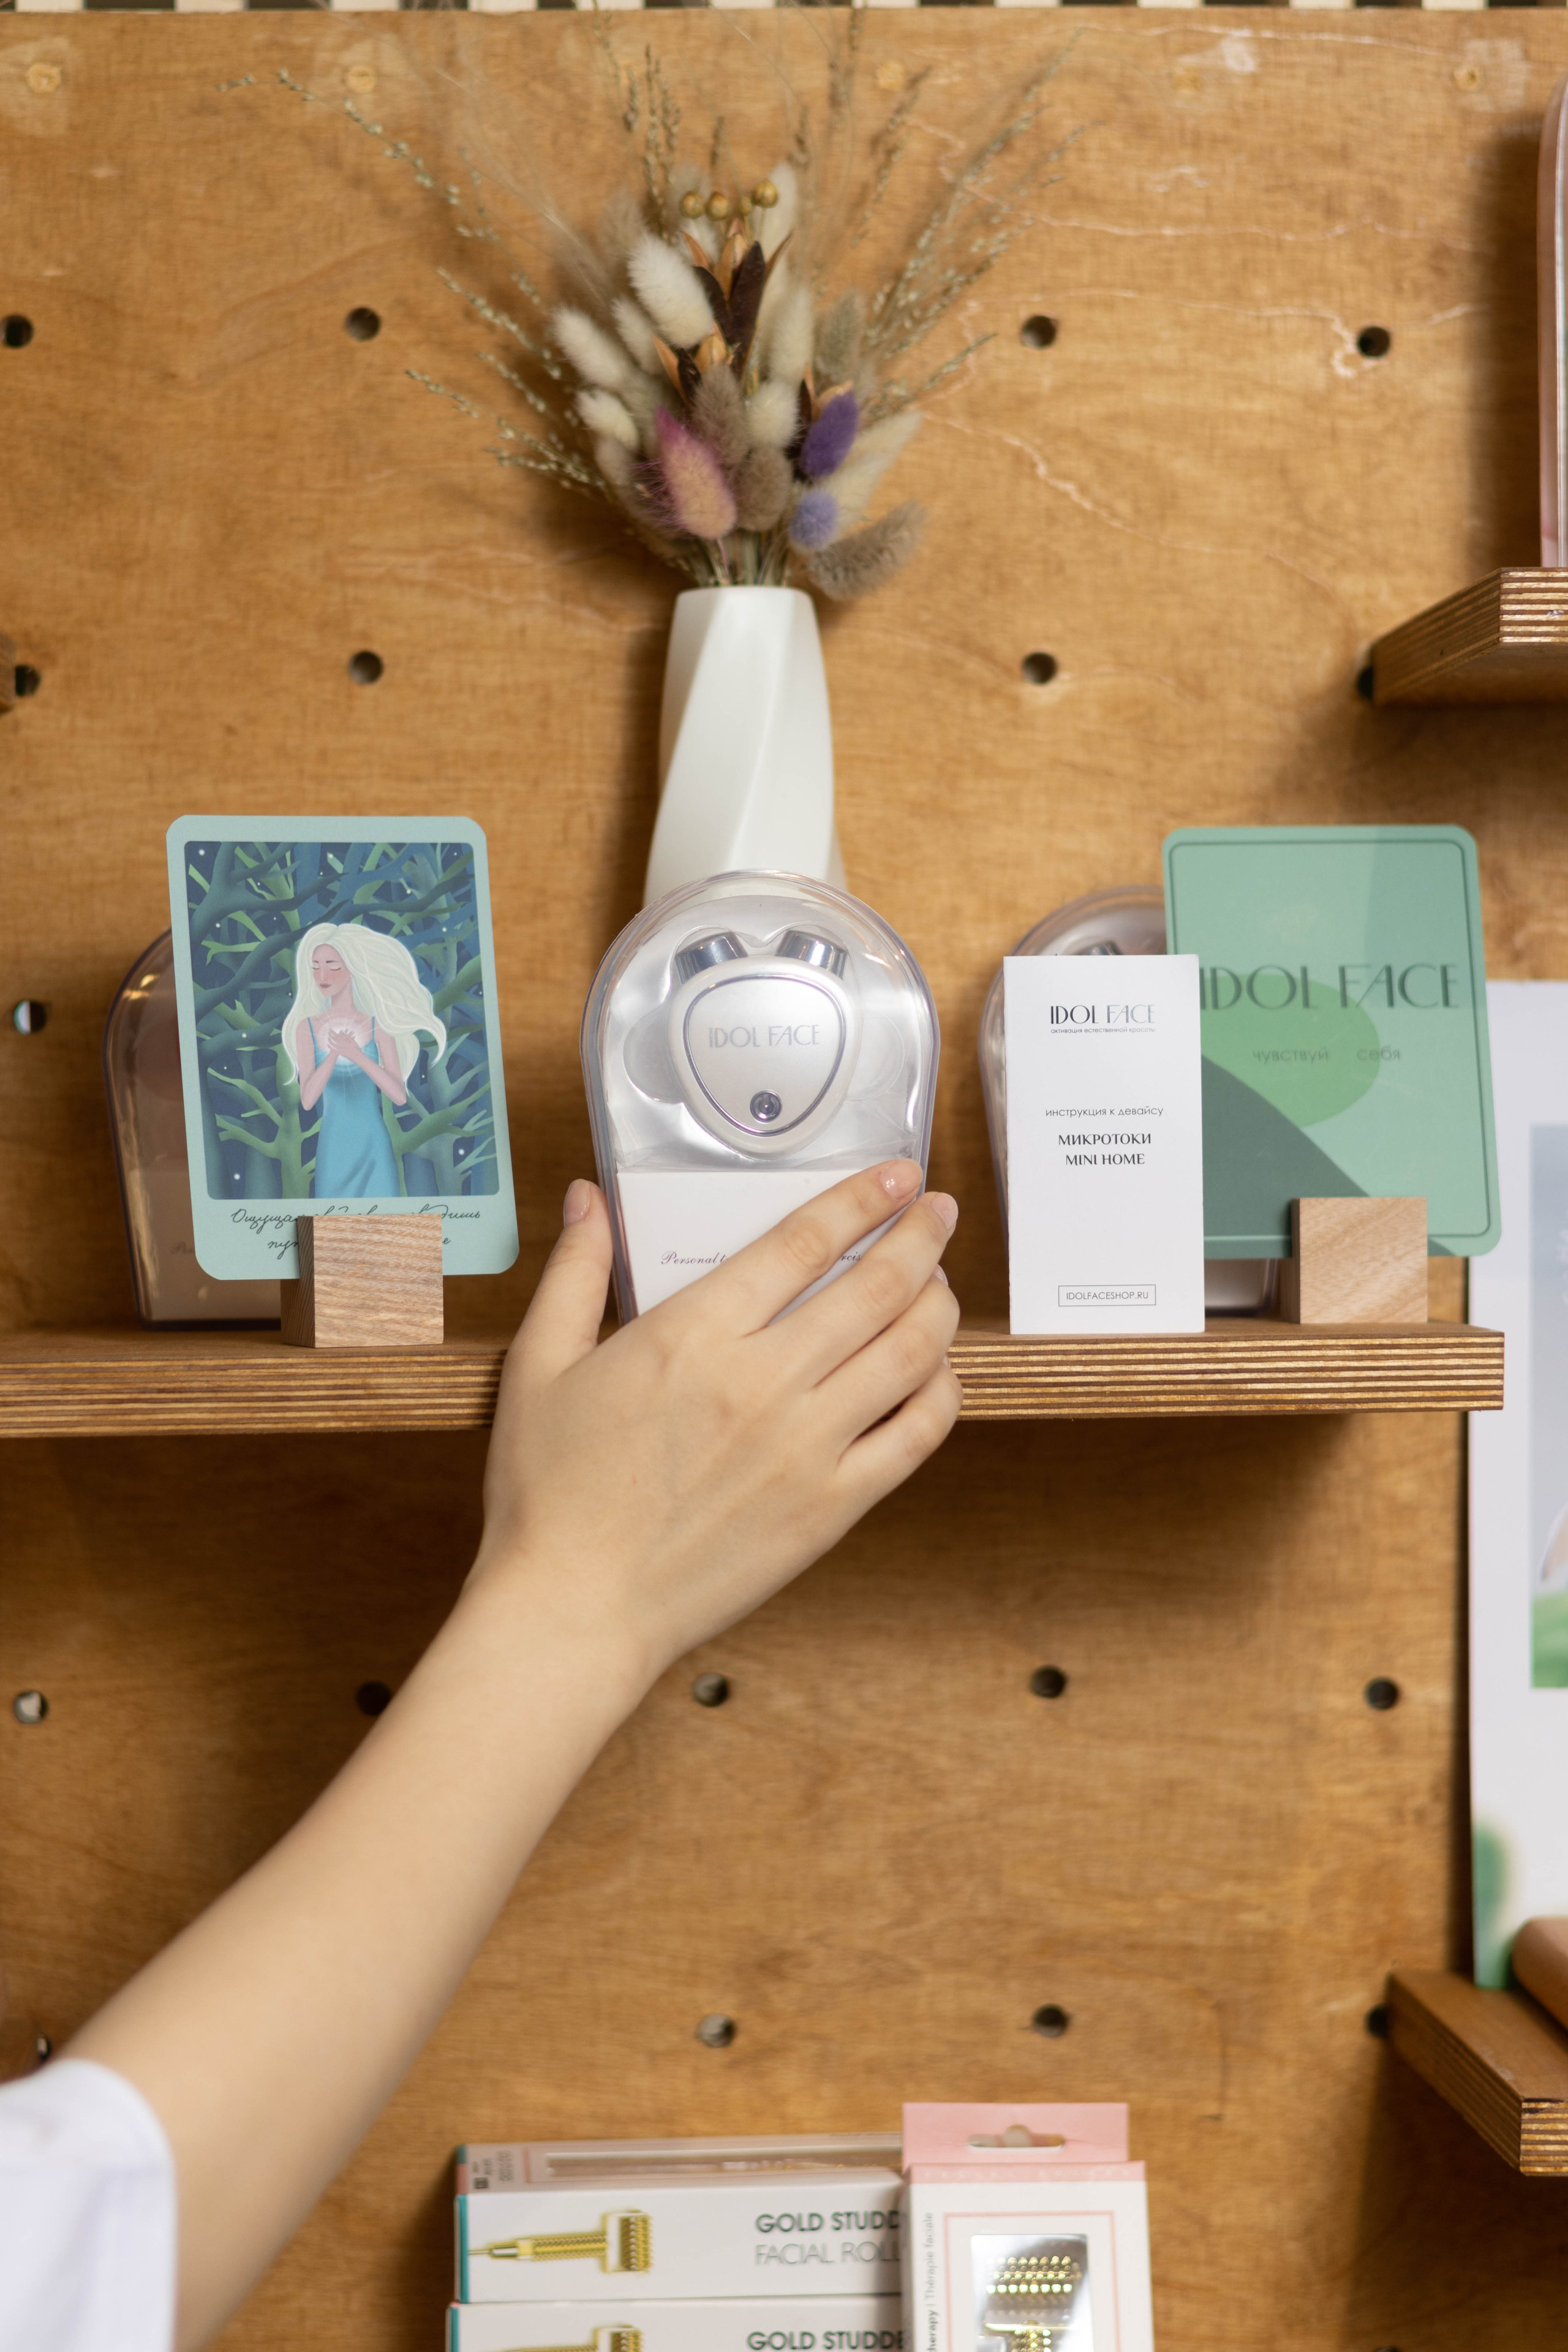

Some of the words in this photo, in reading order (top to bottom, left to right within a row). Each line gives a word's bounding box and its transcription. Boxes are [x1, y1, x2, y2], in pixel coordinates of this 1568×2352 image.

[1199, 963, 1318, 1010] IDOL
[1338, 963, 1460, 1009] FACE
[1050, 1005, 1099, 1025] IDOL
[1107, 1004, 1155, 1024] FACE
[709, 1027, 761, 1049] IDOL
[768, 1024, 820, 1047] FACE
[1253, 1046, 1329, 1064] чувствуй
[1357, 1045, 1400, 1061] себя
[1046, 1109, 1106, 1118] инструкция
[1118, 1106, 1164, 1117] девайсу
[1058, 1133, 1152, 1146] МИКРОТОКИ
[1066, 1154, 1097, 1166] MINI
[1101, 1153, 1145, 1165] HOME
[231, 1208, 298, 1234] Ощуща
[661, 1251, 720, 1265] Personal
[1066, 1291, 1148, 1300] IDOLFACESHOP.RU
[755, 2213, 824, 2233] GOLD
[831, 2210, 899, 2231] STUDD
[755, 2243, 835, 2265] FACIAL
[840, 2241, 900, 2264] ROLL
[747, 2330, 816, 2351] GOLD
[926, 2309, 940, 2352] herapy
